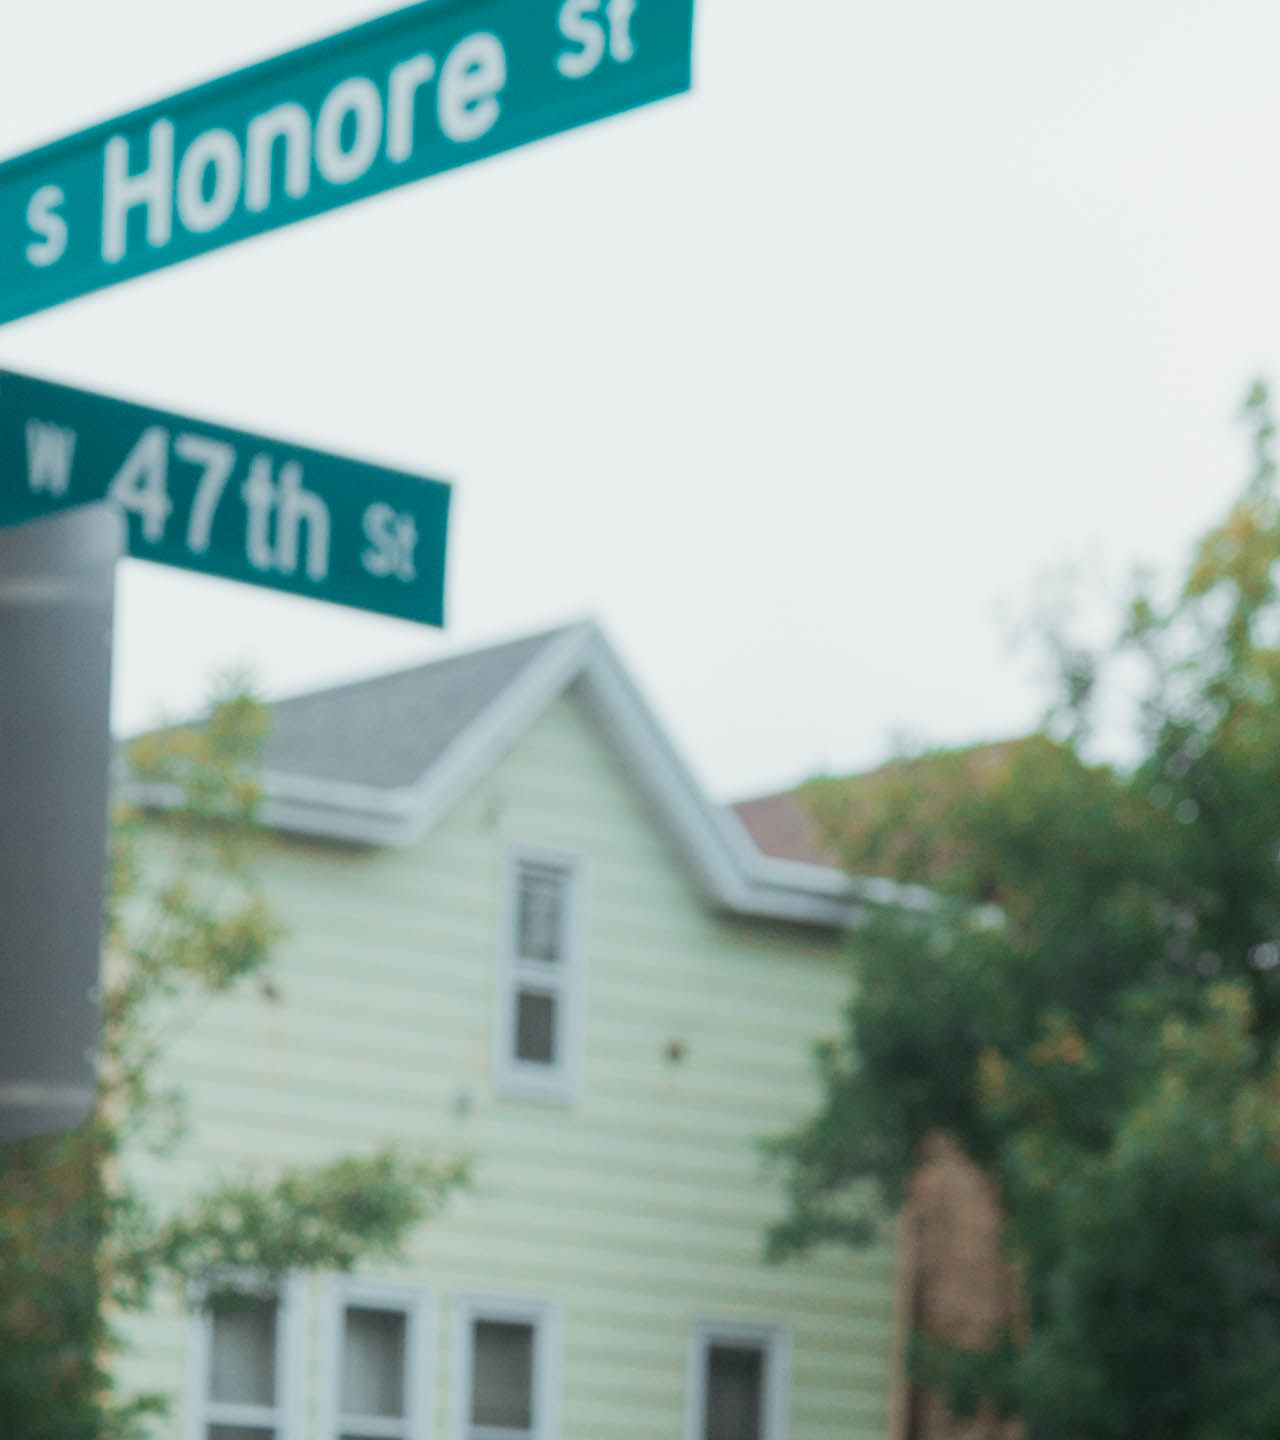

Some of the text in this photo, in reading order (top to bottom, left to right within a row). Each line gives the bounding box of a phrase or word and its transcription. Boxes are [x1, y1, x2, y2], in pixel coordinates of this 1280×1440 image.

[25, 0, 636, 268] S Honore St
[24, 419, 420, 584] W 47th St
